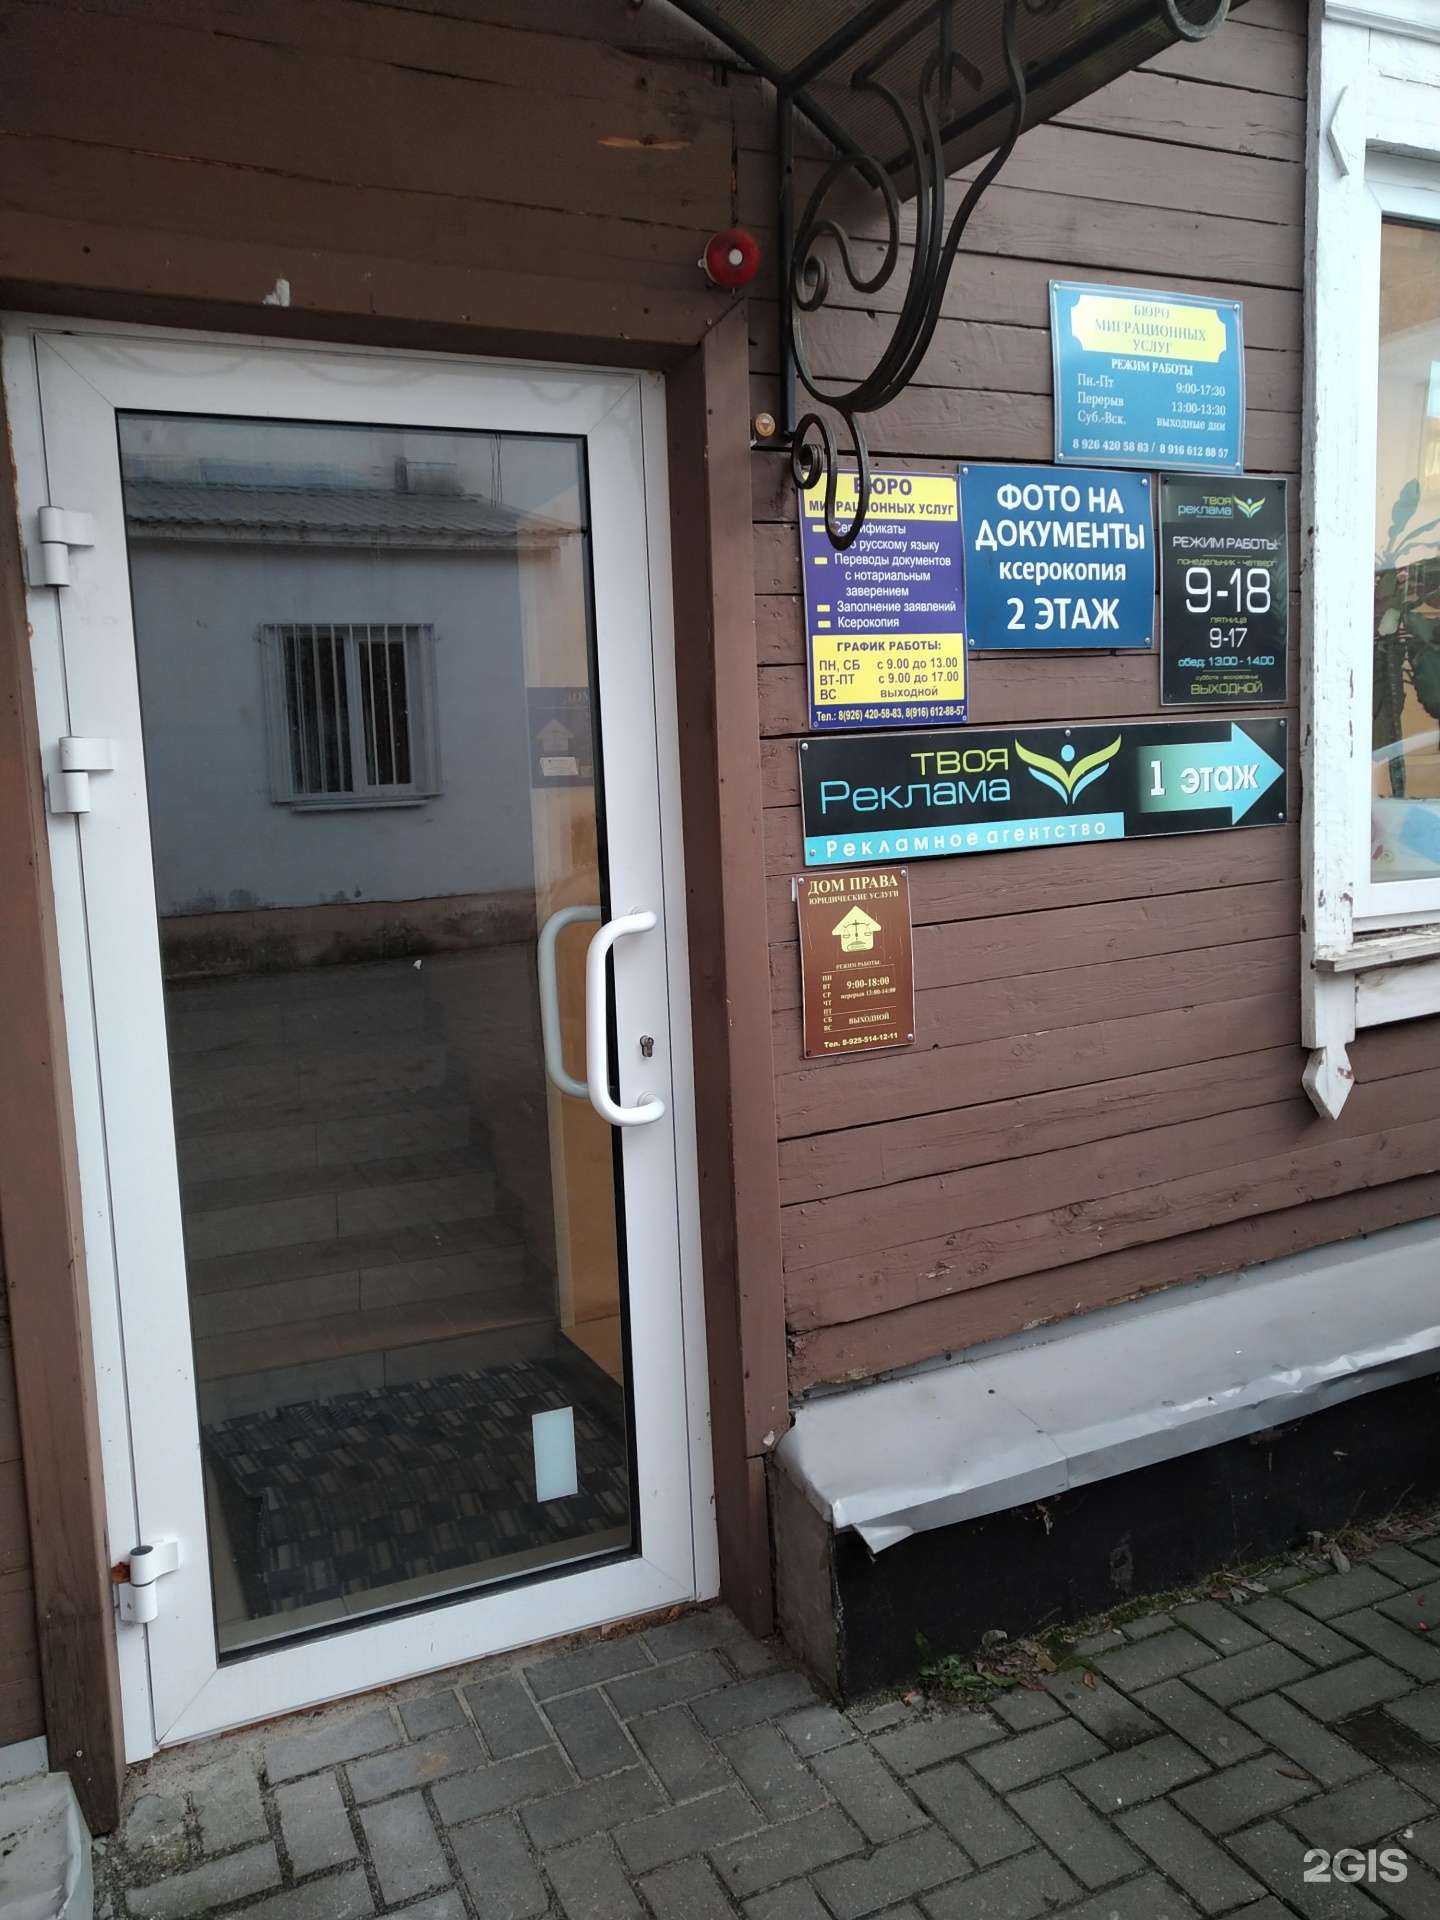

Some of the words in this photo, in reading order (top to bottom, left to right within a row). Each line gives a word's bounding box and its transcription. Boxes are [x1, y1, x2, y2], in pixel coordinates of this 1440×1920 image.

[1134, 303, 1170, 318] БЮРО
[1095, 319, 1207, 341] МИГРАЦИОННЫХ
[1132, 339, 1172, 353] УСЛУГ
[1111, 358, 1150, 372] РЕЖИМ
[1152, 364, 1193, 376] РАБОТЫ
[1077, 373, 1114, 388] Пн.-Пт
[1175, 382, 1226, 396] 9:00-17:30
[1077, 391, 1125, 408] Перерыв
[1172, 401, 1226, 416] 13:00-13:30
[1077, 410, 1126, 425] Суб.-Вск.
[1072, 439, 1079, 448] 8
[1103, 440, 1121, 451] 420
[1159, 444, 1166, 454] 8
[1168, 444, 1185, 455] 916
[997, 483, 1081, 512] ФОТО
[1088, 486, 1125, 514] НА
[919, 504, 954, 516] УСЛУГ
[975, 519, 1146, 552] ДОКУМЕНТЫ
[1173, 536, 1224, 549] РЕЖИМ
[859, 541, 908, 552] русскому
[910, 541, 940, 553] языку
[834, 553, 890, 567] Переводы
[892, 556, 952, 567] документов
[845, 572, 852, 580] с
[854, 571, 931, 582] нотариальным
[1000, 561, 1127, 586] ксерокопия
[845, 587, 909, 598] заверением
[1185, 567, 1271, 613] 9-18
[836, 601, 902, 613] Заполнение
[903, 600, 957, 612] заявлений
[1006, 597, 1026, 630] 2
[1033, 597, 1120, 630] ЭТАЖ
[837, 616, 900, 630] Ксерокопия
[1209, 627, 1248, 648] 9-17
[836, 641, 885, 652] ГРАФИК
[889, 640, 942, 651] РАБОТЫ:
[819, 659, 840, 672] ПН,
[843, 659, 861, 671] СБ
[886, 657, 910, 670] 9.00
[912, 659, 927, 670] до
[931, 657, 958, 669] 13.00
[819, 673, 855, 686] ВТ-ПТ
[887, 672, 911, 684] 9.00
[913, 674, 928, 685] до
[931, 671, 959, 682] 17.00
[820, 688, 837, 700] ВС
[816, 711, 837, 722] Тел.:
[838, 709, 863, 722] 8(926)
[905, 707, 929, 718] 8(916)
[930, 705, 965, 717] 612-88-57
[1150, 760, 1167, 796] 1
[1180, 762, 1260, 794] этаж
[820, 778, 1011, 815] Реклама
[826, 829, 981, 858] Рекламное
[986, 822, 1106, 845] агентство
[808, 878, 845, 896] ДОМ
[850, 874, 898, 890] ПРАВА
[809, 891, 868, 905] ЮРИДИЧЕСКИЕ
[869, 890, 899, 900] УСЛУГИ
[846, 976, 890, 989] 9:00-18:00
